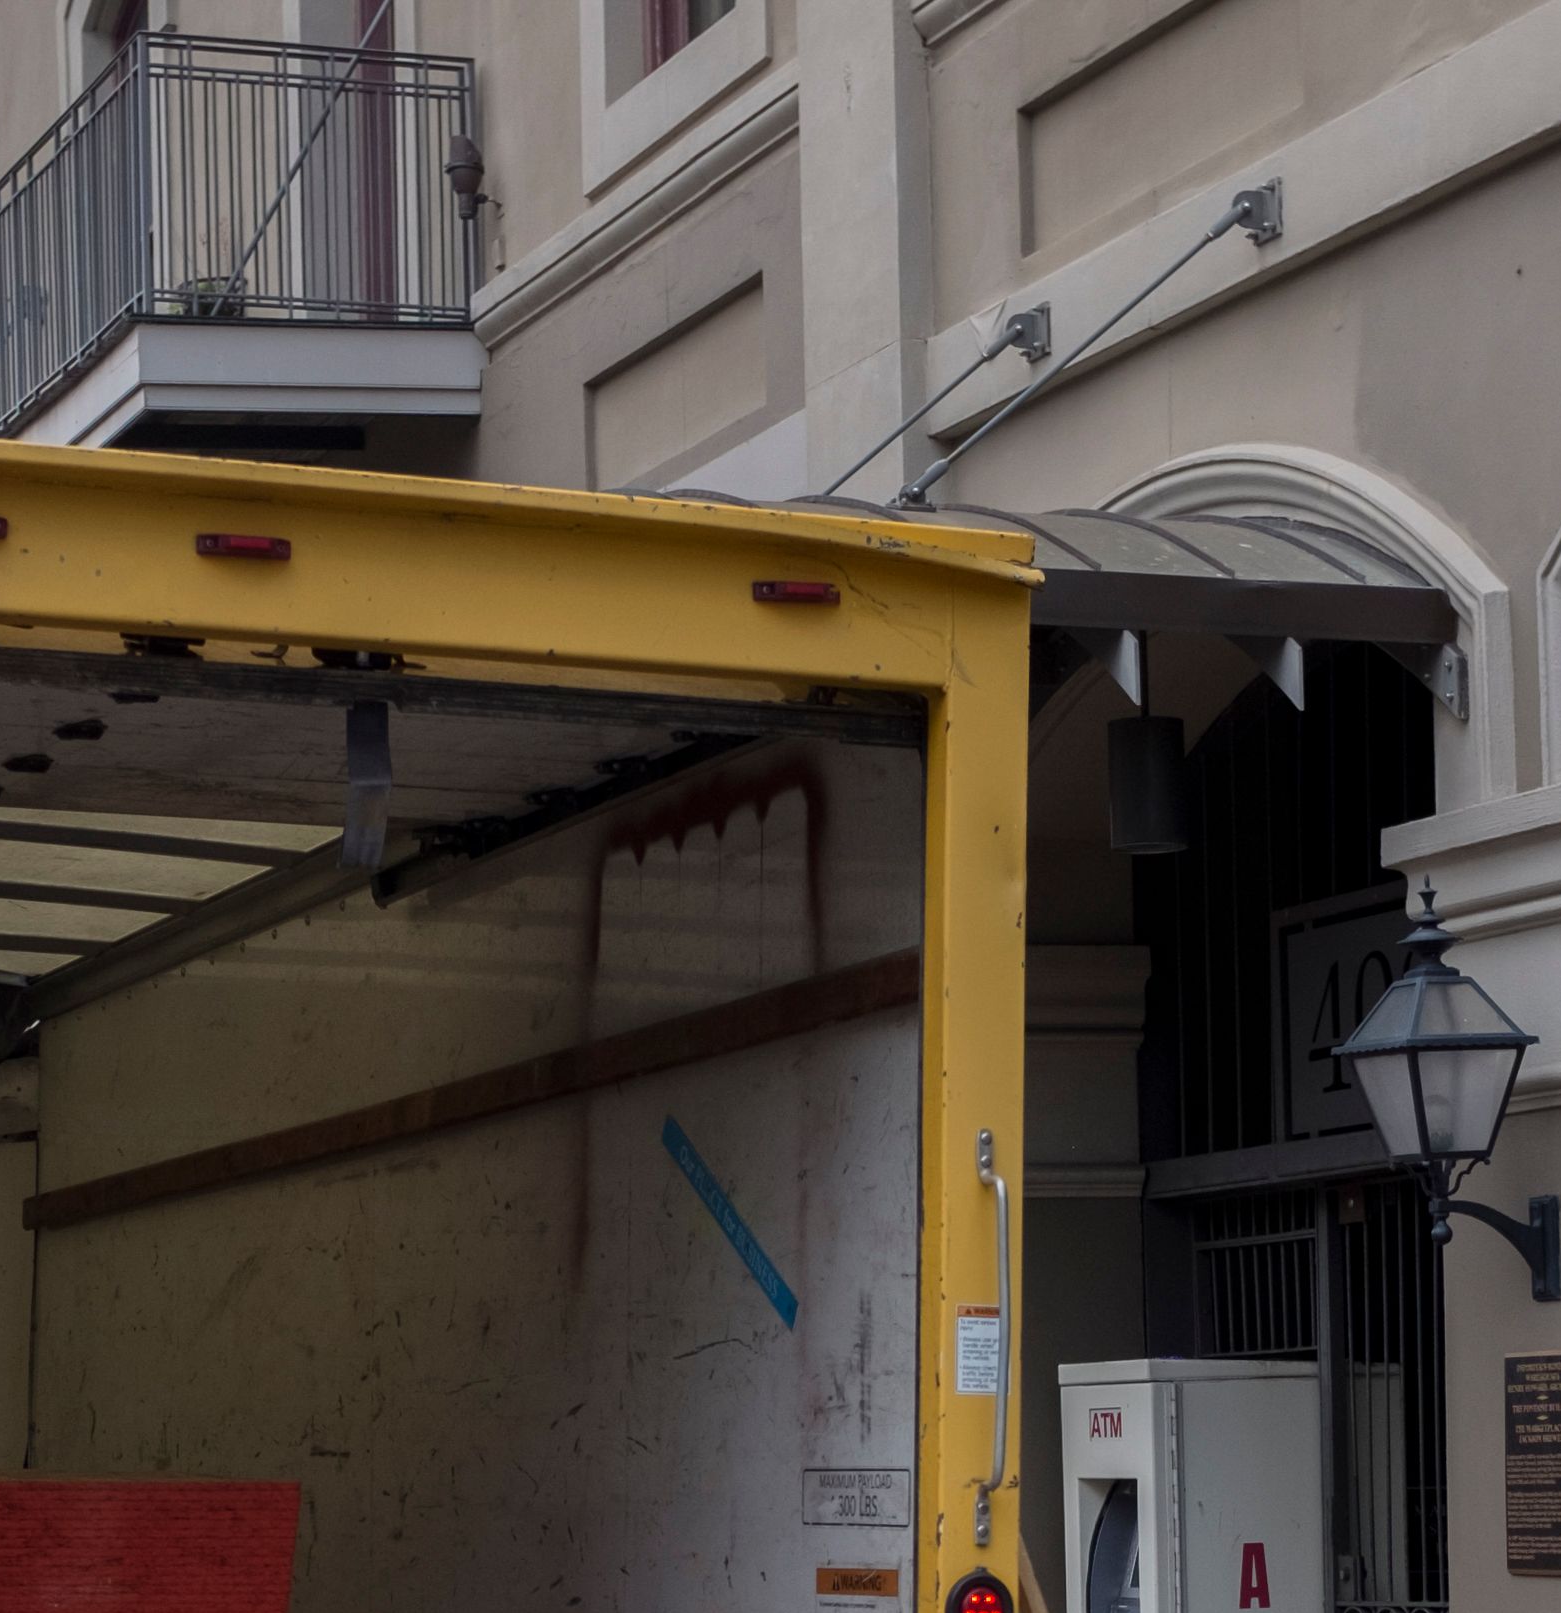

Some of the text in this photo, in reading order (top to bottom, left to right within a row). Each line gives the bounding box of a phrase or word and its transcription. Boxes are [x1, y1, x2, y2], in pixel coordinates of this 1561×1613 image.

[1091, 1412, 1122, 1438] ATM
[819, 1474, 893, 1489] MAXIMUM PAYLOAD
[840, 1574, 882, 1591] WARNING
